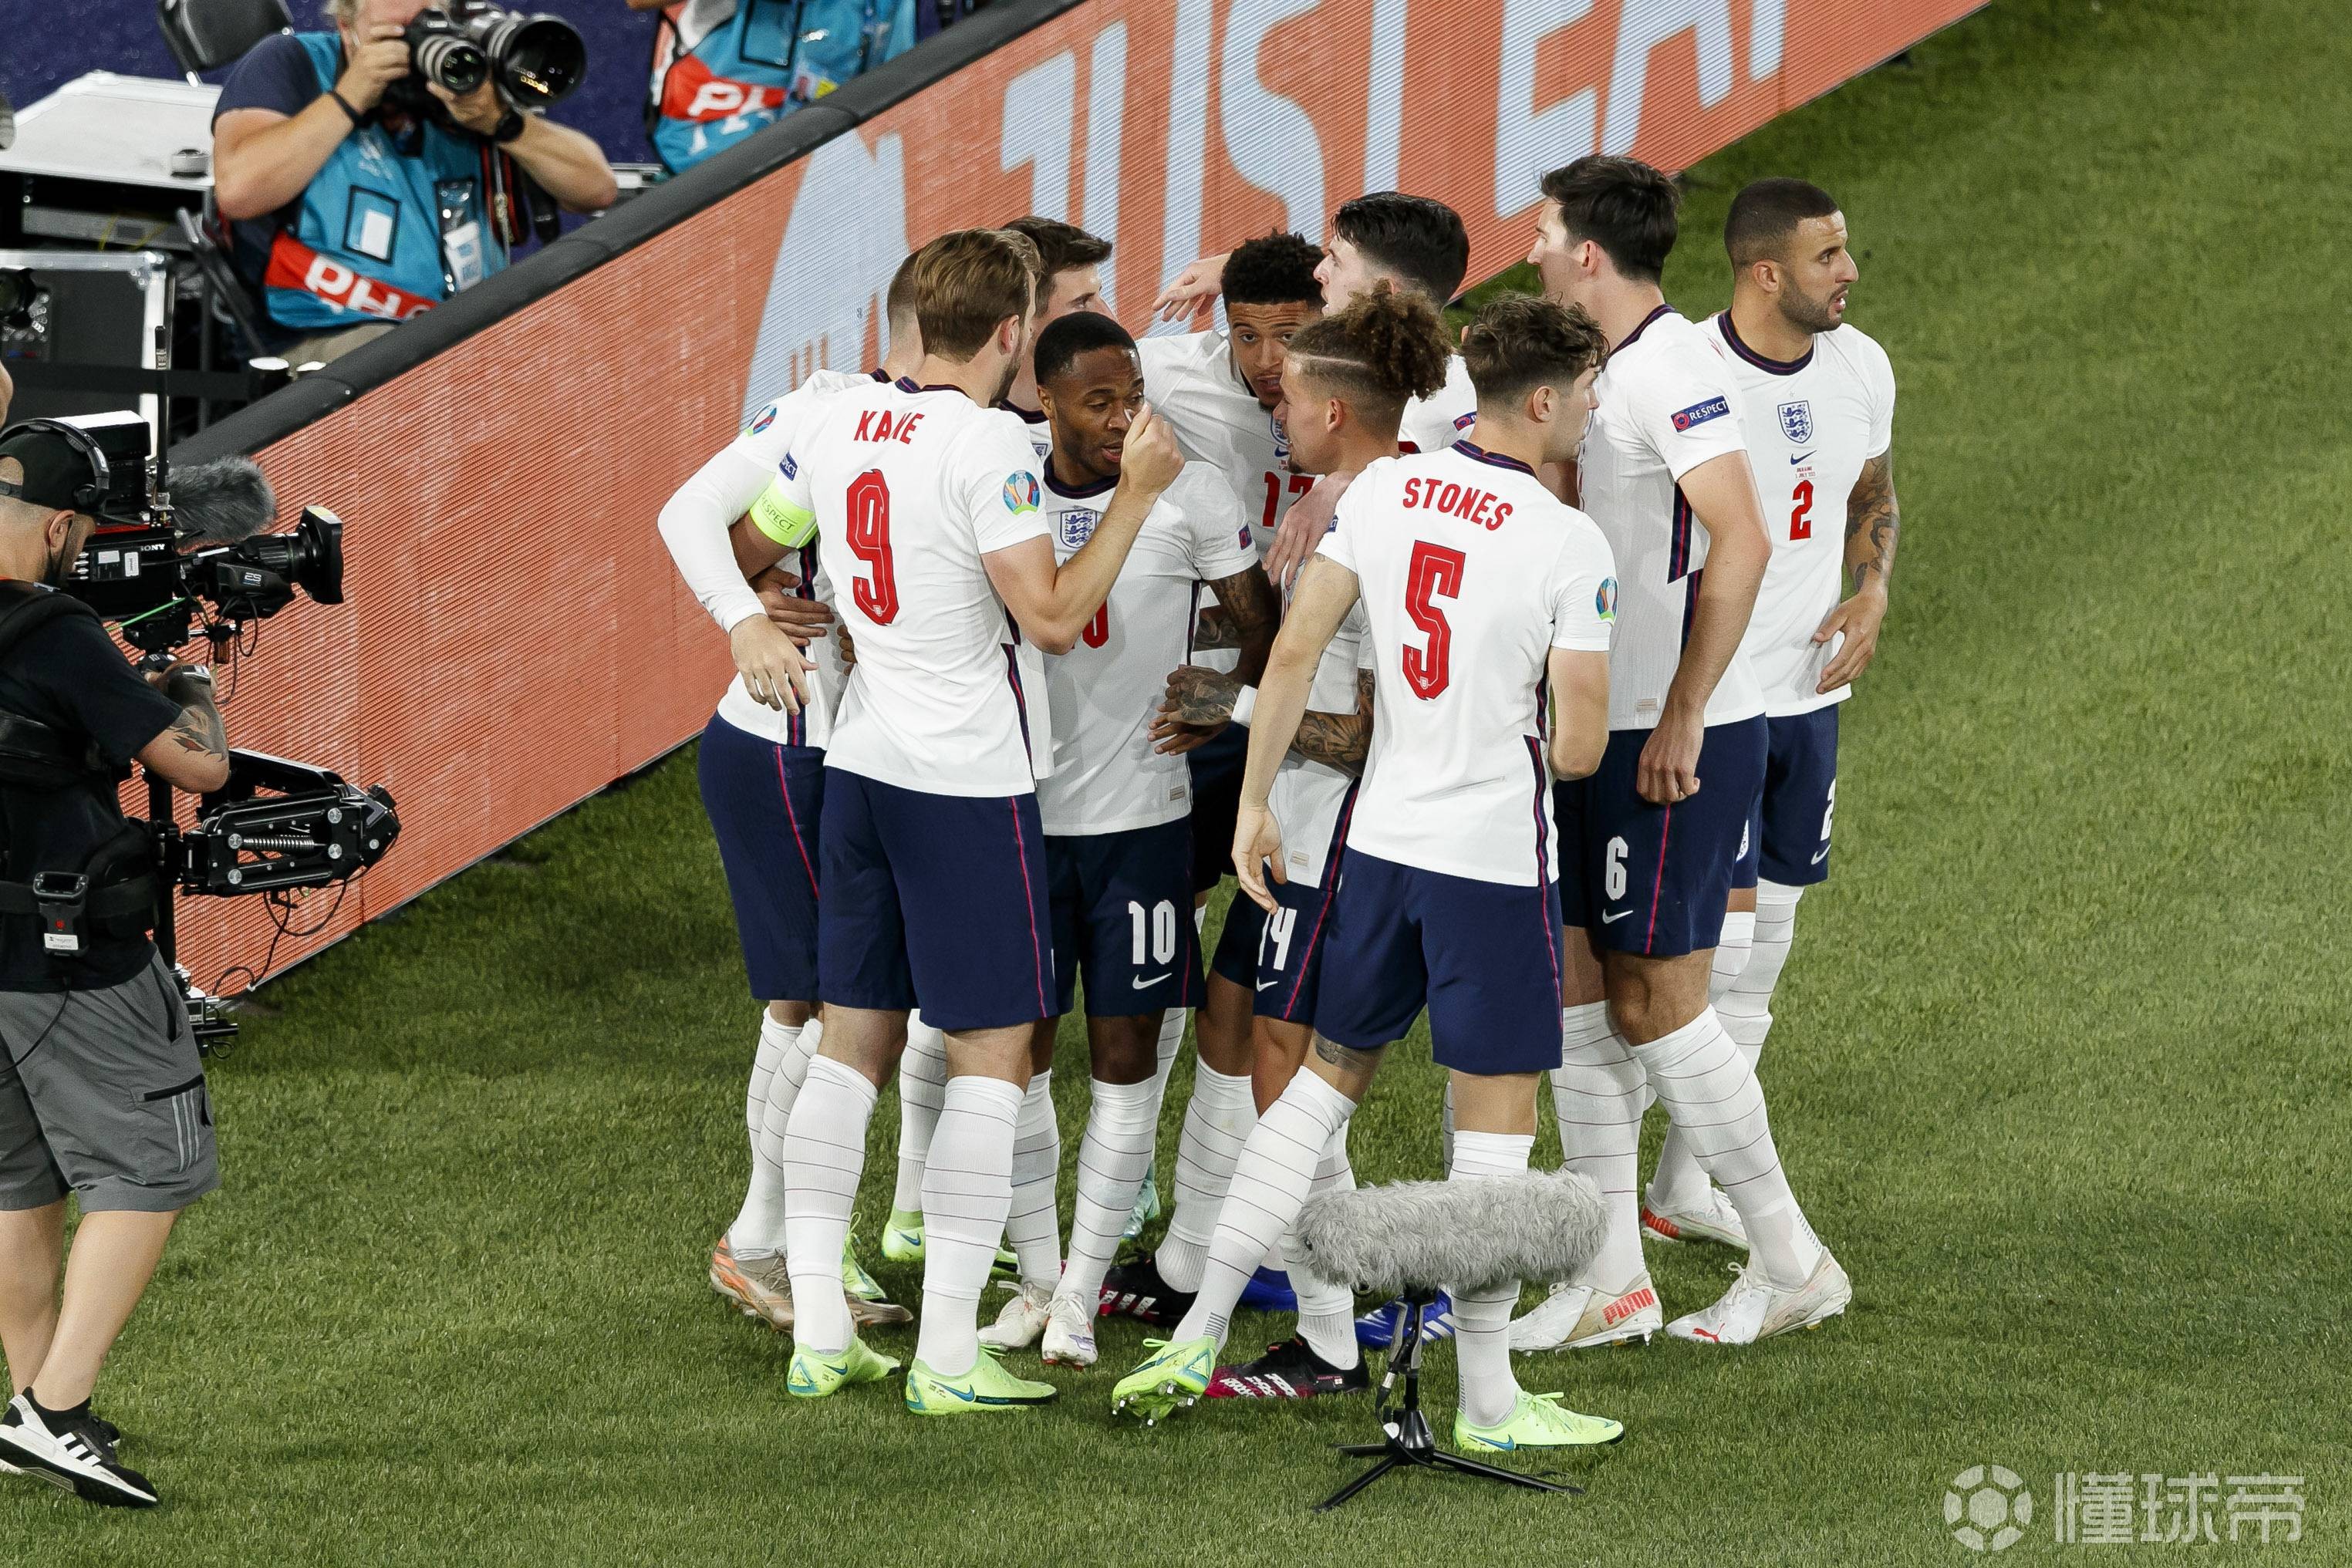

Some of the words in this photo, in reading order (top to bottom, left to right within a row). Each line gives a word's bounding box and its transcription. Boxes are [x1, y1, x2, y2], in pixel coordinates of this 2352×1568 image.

[1689, 401, 1728, 421] RESPECT
[1402, 477, 1513, 531] STONES
[1790, 479, 1814, 541] 2
[141, 543, 165, 551] SONY
[846, 468, 899, 626] 9
[1402, 539, 1466, 700] 5
[1605, 835, 1628, 901] 6
[1129, 899, 1176, 965] 10
[1603, 1288, 1655, 1325] PUMA
